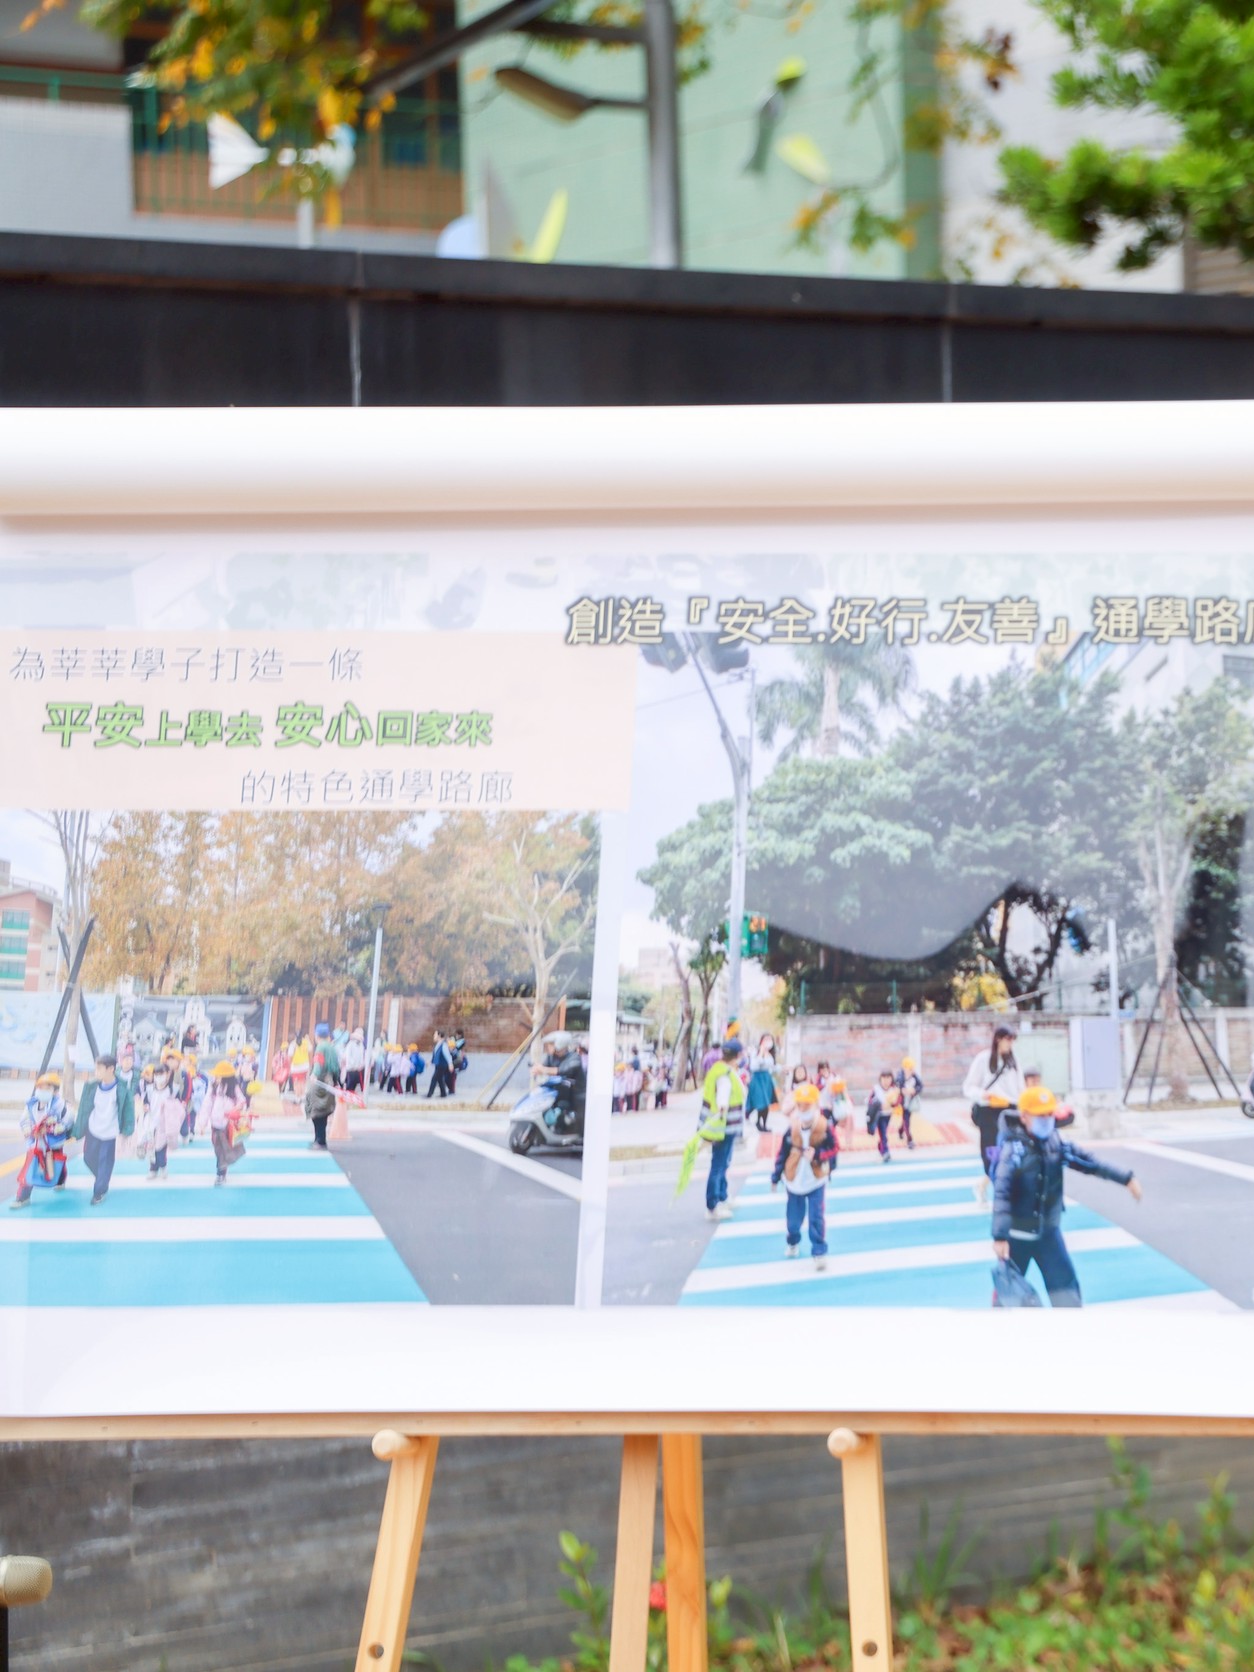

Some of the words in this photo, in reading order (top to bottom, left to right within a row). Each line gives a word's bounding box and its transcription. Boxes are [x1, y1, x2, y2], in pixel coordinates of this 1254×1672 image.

[10, 646, 364, 682] 為莘莘學子打造一條
[240, 767, 514, 805] 的特色通學路廊
